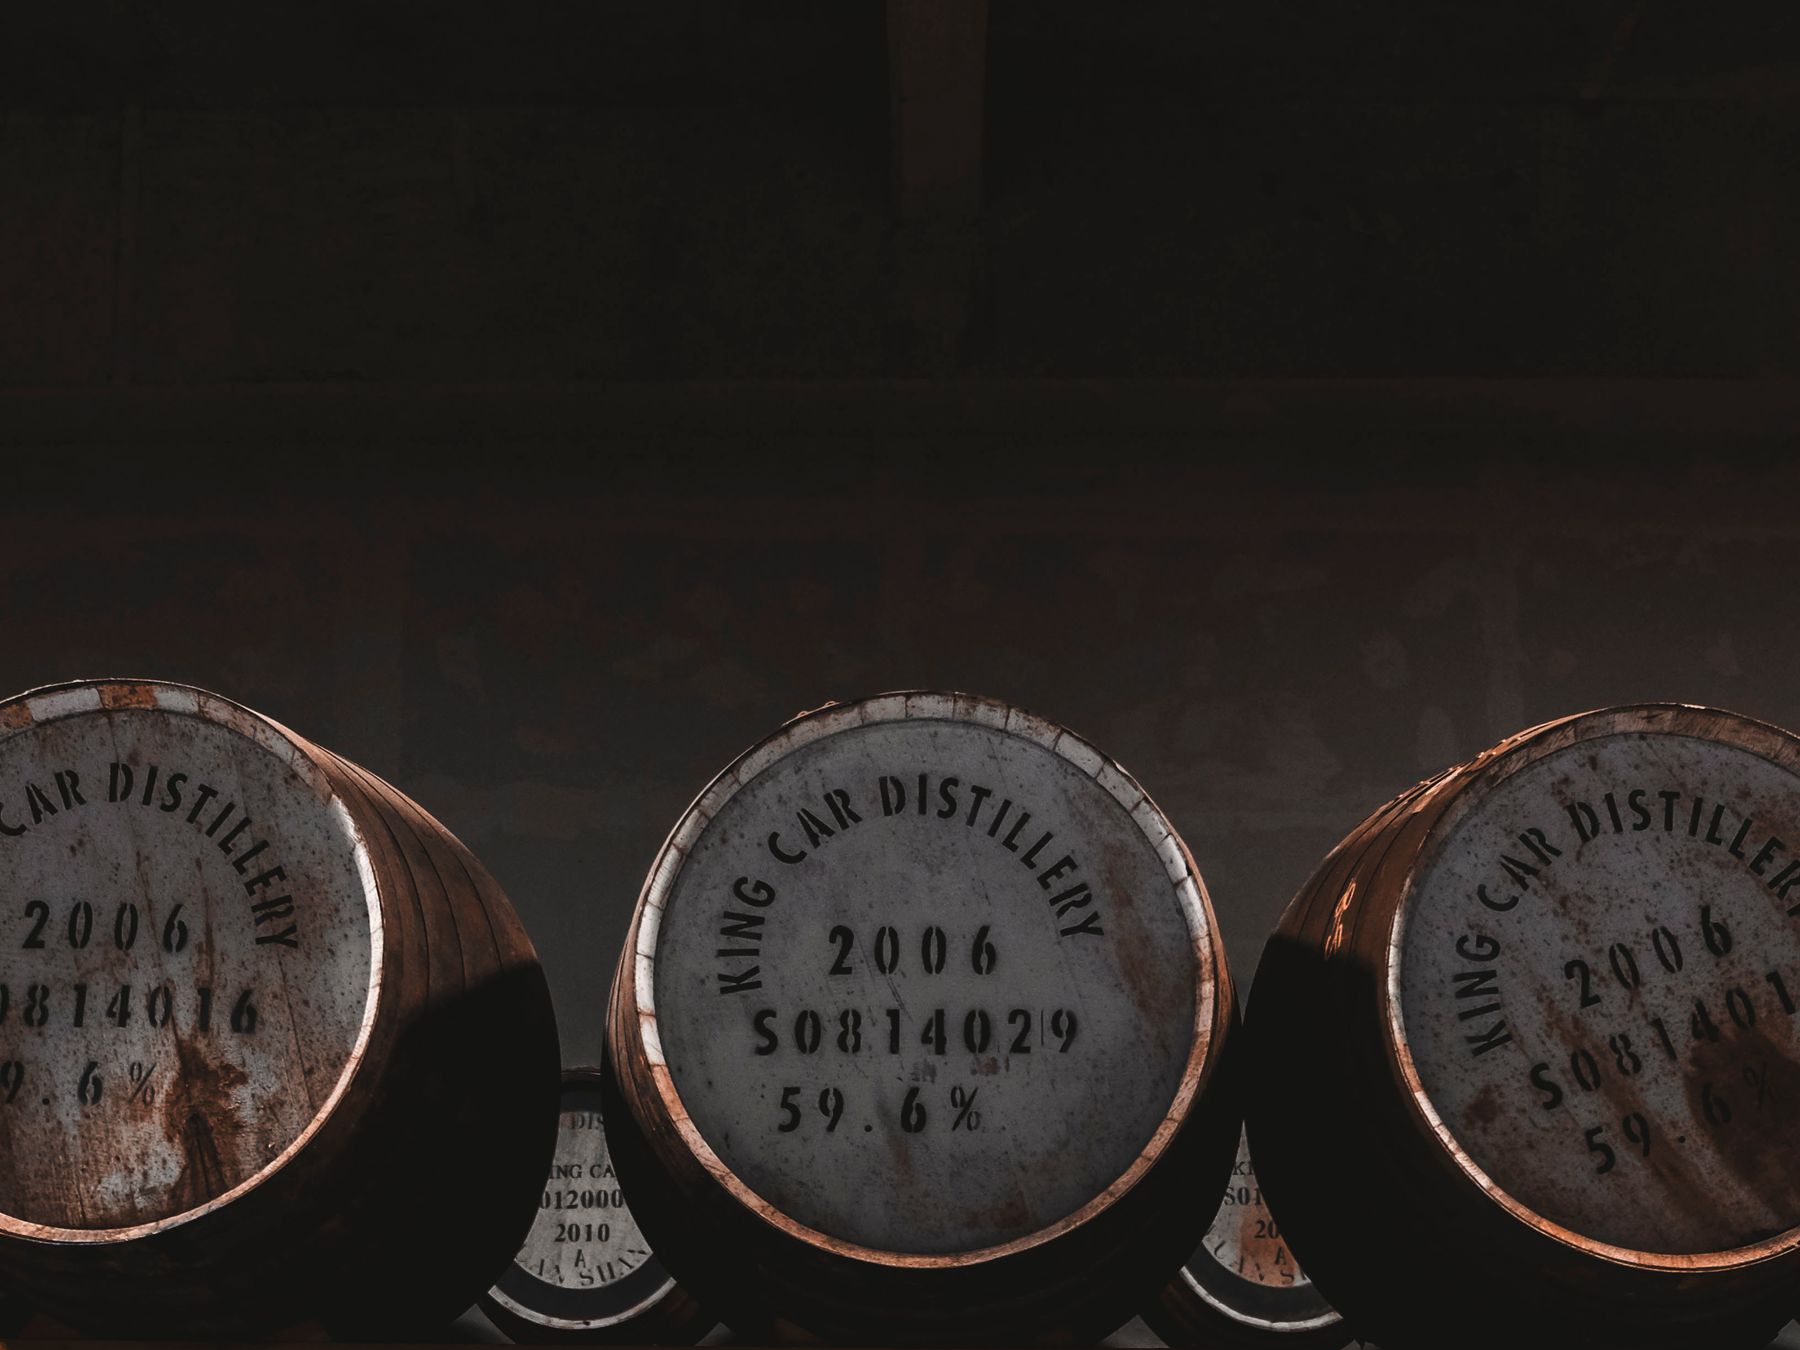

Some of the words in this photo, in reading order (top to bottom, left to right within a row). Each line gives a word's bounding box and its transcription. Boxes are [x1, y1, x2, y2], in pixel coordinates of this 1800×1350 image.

[108, 762, 298, 949] DISTILLERY
[717, 876, 775, 995] KING
[768, 788, 862, 864] CAR
[878, 773, 1105, 939] DISTILLERY
[1478, 827, 1561, 912] CAR
[23, 901, 188, 952] 2006
[828, 925, 997, 976] 2006
[1564, 905, 1733, 1009] 2006
[754, 1008, 1079, 1056] S0814029
[1453, 933, 1512, 1057] KING
[554, 1223, 610, 1242] 2010
